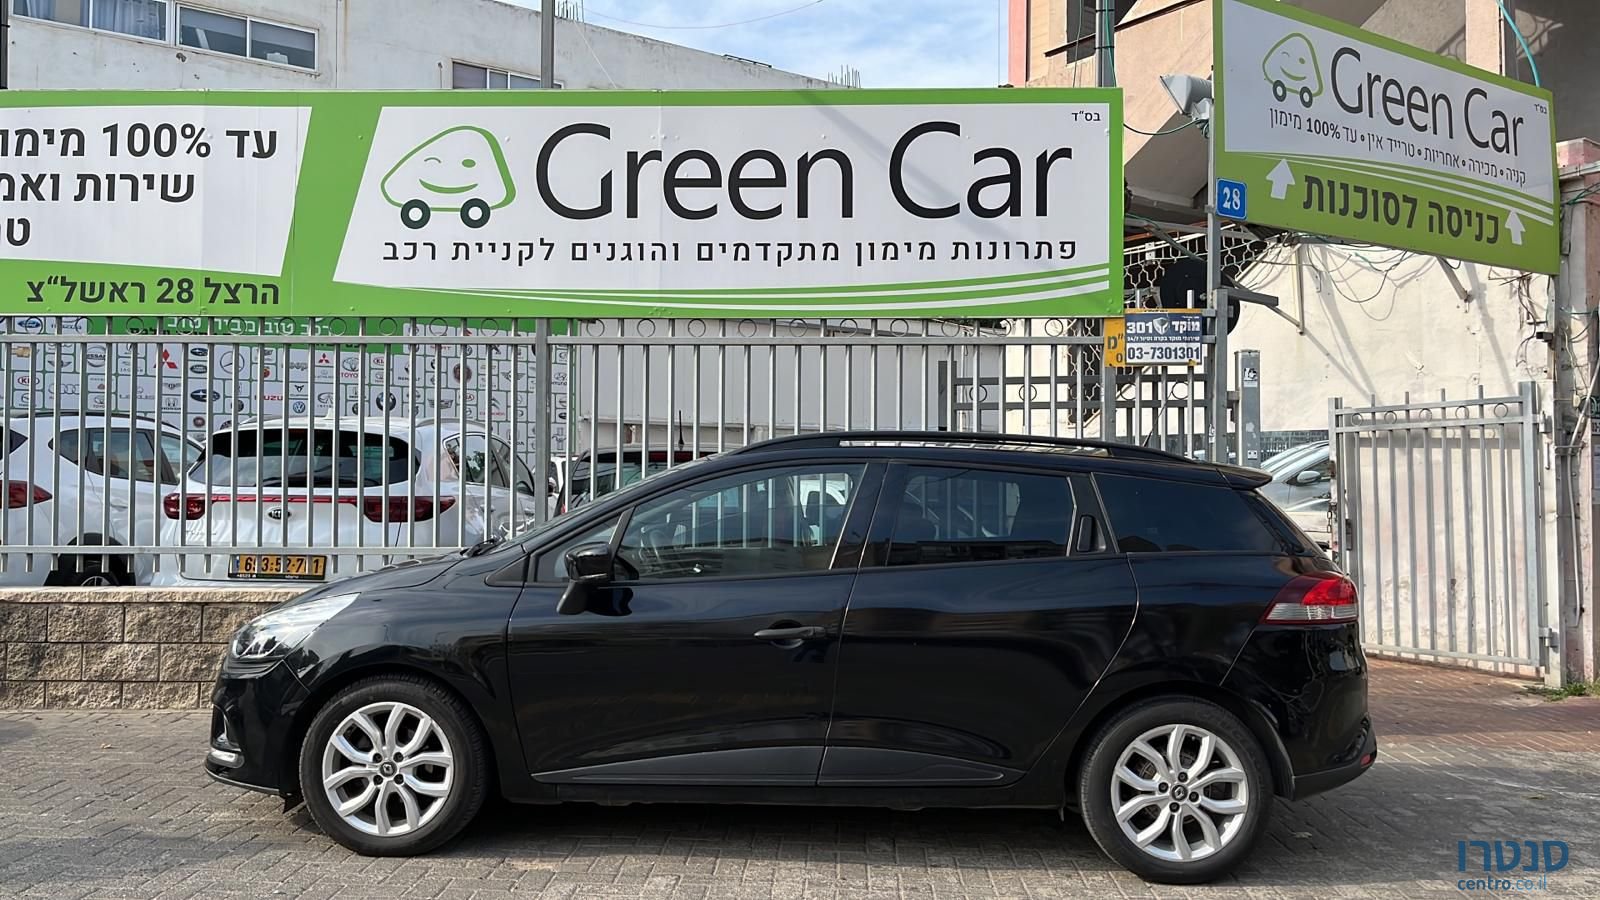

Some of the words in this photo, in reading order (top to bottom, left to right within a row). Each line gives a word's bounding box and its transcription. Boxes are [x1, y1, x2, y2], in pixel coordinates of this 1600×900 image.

[1331, 46, 1454, 140] Green
[1464, 87, 1524, 157] Car
[1071, 110, 1101, 121] בס"ד
[1269, 107, 1302, 130] מימון
[1306, 117, 1341, 140] 100%
[1342, 126, 1357, 144] עד
[103, 123, 211, 158] 100%
[226, 129, 277, 159] עד
[1367, 132, 1383, 152] אין
[1387, 137, 1415, 158] טרייד
[1424, 147, 1460, 169] אחריות
[1468, 158, 1498, 177] מכירה
[536, 122, 853, 220] Green
[889, 121, 1073, 219] Car
[1505, 166, 1526, 188] קניה
[73, 173, 195, 203] שירות
[1222, 186, 1241, 211] 28
[1303, 175, 1418, 229] לסוכנות
[1428, 201, 1499, 244] כניסה
[382, 241, 437, 262] רכב
[451, 237, 556, 267] לקניית
[571, 241, 680, 262] והוגנים
[697, 241, 840, 267] מתקדמים
[855, 241, 936, 267] מימון
[950, 241, 1077, 261] פתרונות
[27, 275, 146, 303] ראשל"צ
[157, 277, 194, 304] 28
[204, 277, 280, 304] הרצל
[1126, 321, 1153, 334] 301
[1171, 319, 1200, 334] מוקד
[1127, 346, 1200, 360] 03-7301301
